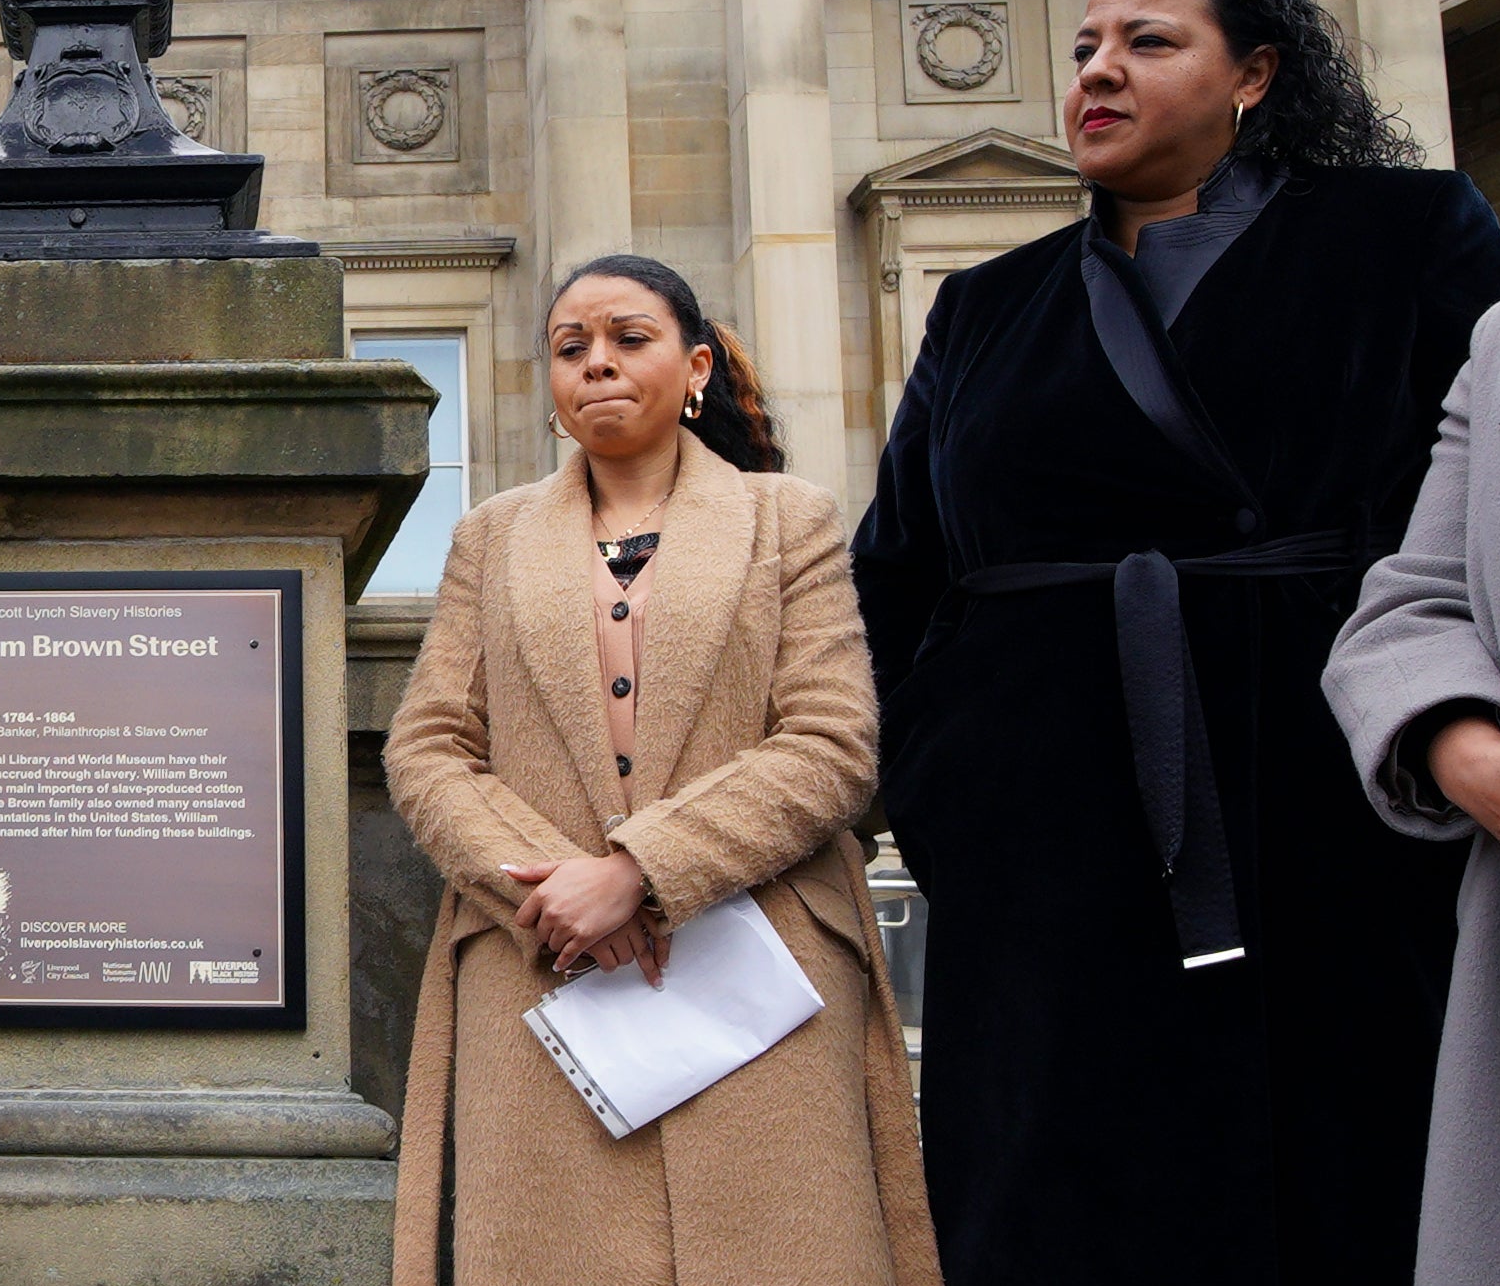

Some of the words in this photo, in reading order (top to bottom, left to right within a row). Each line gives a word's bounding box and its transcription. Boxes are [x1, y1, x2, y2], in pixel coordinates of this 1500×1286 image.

[27, 606, 65, 621] Lynch
[70, 606, 120, 620] Slavery
[124, 605, 182, 617] Histories
[33, 635, 122, 657] Brown
[129, 635, 218, 656] Street
[3, 712, 34, 723] 1784
[44, 712, 75, 723] 1864
[43, 726, 120, 739] Philanthropist
[123, 726, 131, 737] &
[135, 726, 166, 737] Slave
[170, 726, 208, 736] Owner
[9, 754, 50, 767] Library
[53, 755, 75, 764] and
[78, 754, 112, 764] World
[116, 754, 165, 764] Museum
[169, 754, 196, 764] have
[200, 754, 227, 764] their
[45, 769, 91, 781] through
[94, 769, 139, 781] slavery.
[143, 769, 185, 779] William
[189, 769, 227, 779] Brown
[6, 783, 34, 793] main
[38, 783, 93, 795] importers
[97, 783, 109, 793] of
[112, 783, 202, 795] slave-produced
[205, 784, 243, 793] cotton
[8, 798, 45, 808] Brown
[49, 798, 84, 810] family
[87, 798, 112, 808] also
[115, 798, 154, 808] owned
[157, 800, 189, 810] many
[192, 798, 245, 808] enslaved
[55, 812, 65, 822] in
[68, 812, 86, 822] the
[90, 812, 128, 822] United
[131, 812, 171, 823] States.
[175, 812, 218, 822] William
[0, 827, 38, 837] named
[42, 827, 68, 837] after
[71, 827, 92, 837] him
[96, 827, 112, 837] for
[115, 827, 159, 839] funding
[162, 827, 194, 837] these
[198, 827, 255, 840] buildings.
[21, 922, 86, 933] DISCOVER
[89, 922, 126, 933] MORE
[21, 937, 203, 951] liverpoolslaveryhistories.co.uk
[47, 964, 79, 973] Liverpool
[212, 961, 259, 970] LIVERPOOL
[47, 972, 61, 980] City
